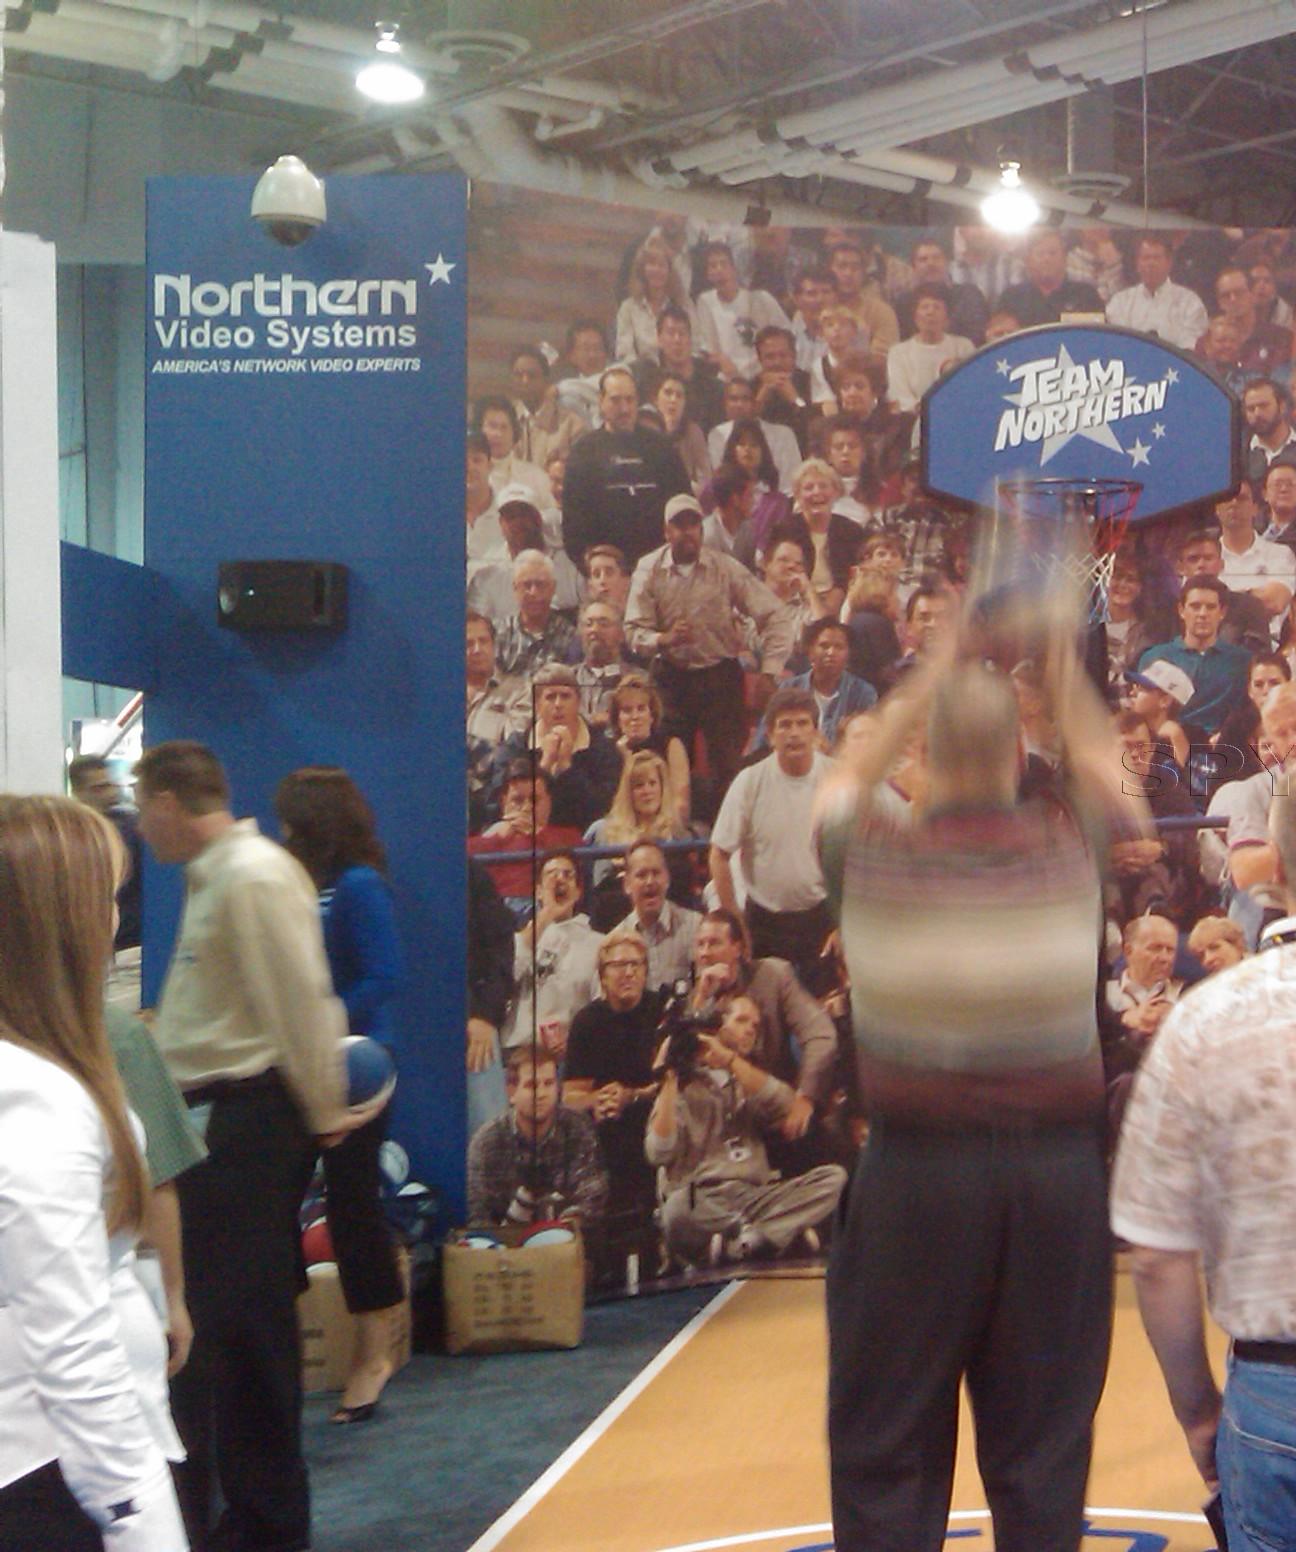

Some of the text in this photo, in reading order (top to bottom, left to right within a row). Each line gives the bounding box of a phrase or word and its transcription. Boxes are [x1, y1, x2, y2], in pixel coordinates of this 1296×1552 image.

[154, 273, 417, 317] Northern
[154, 319, 417, 355] Video Systems
[152, 357, 421, 374] AMERICA'S NETWORK VIDEO EXPERTS
[1008, 357, 1126, 409] TEAM
[993, 380, 1169, 452] NORTHERN
